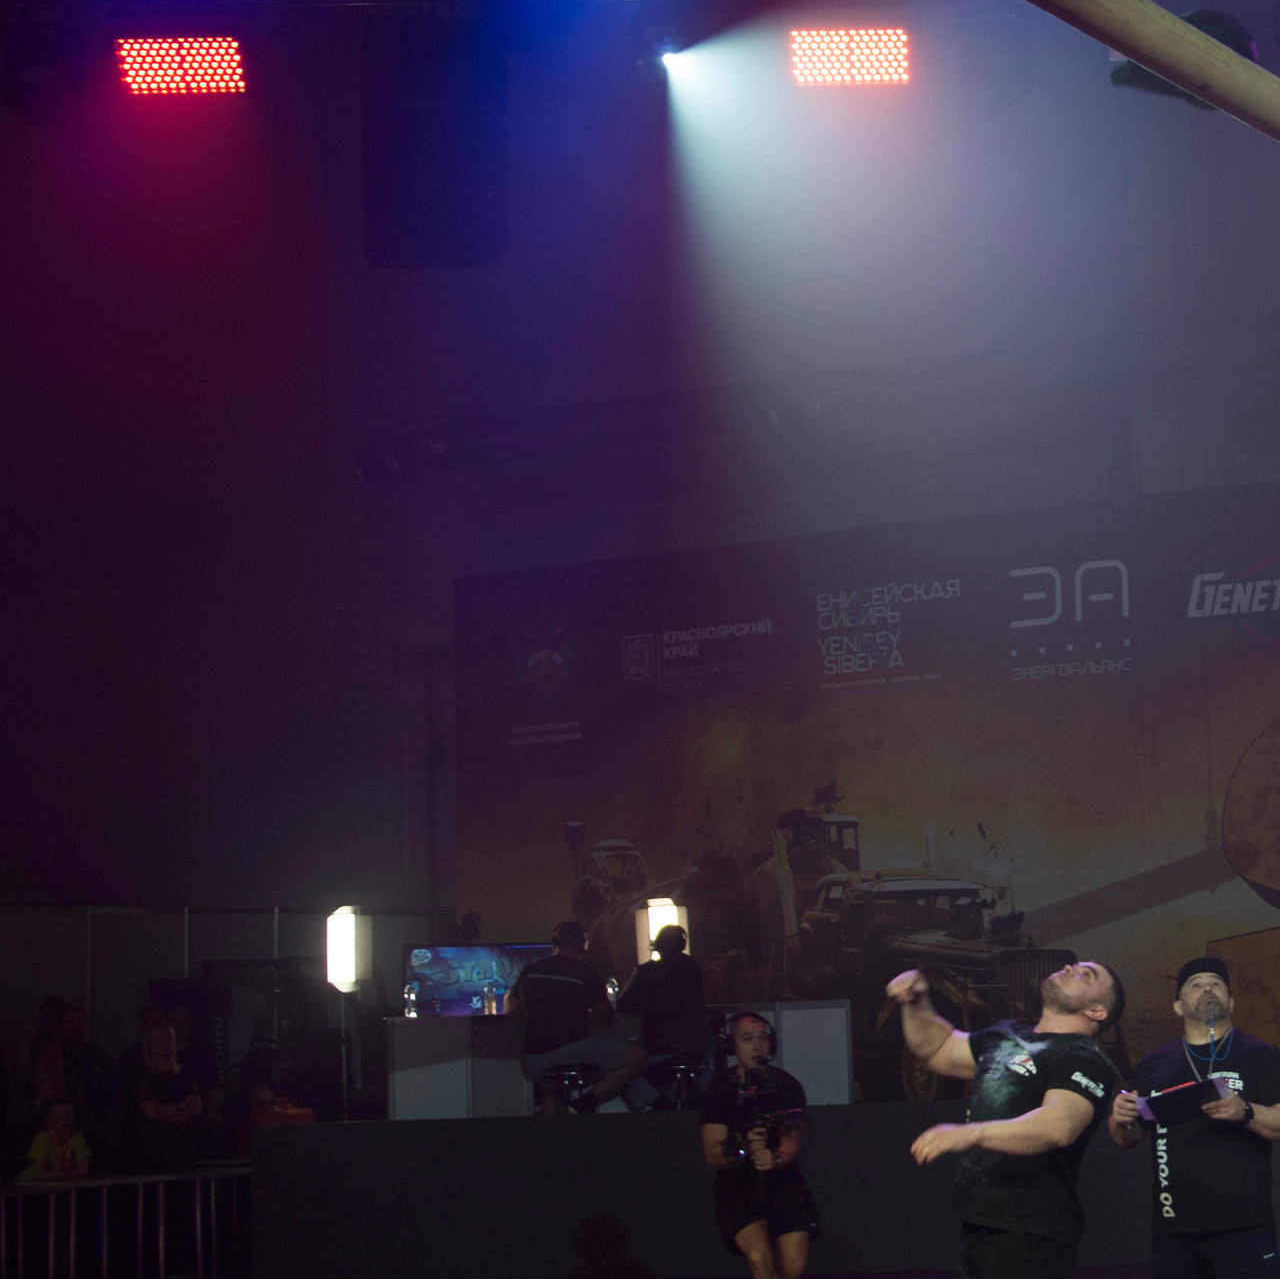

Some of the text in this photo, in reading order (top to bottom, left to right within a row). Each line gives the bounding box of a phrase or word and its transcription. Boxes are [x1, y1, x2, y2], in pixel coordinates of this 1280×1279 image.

[816, 578, 961, 613] ЕНИСЕЙСКАЯ
[662, 617, 773, 645] КРАСНОЯРСКИЙ
[816, 605, 901, 631] СИБИРЬ
[662, 641, 699, 660] КРАЙ
[816, 629, 902, 657] YENISEY
[823, 649, 905, 676] SIBERIA
[1156, 1137, 1169, 1188] YOUR
[1159, 1192, 1176, 1218] DO
